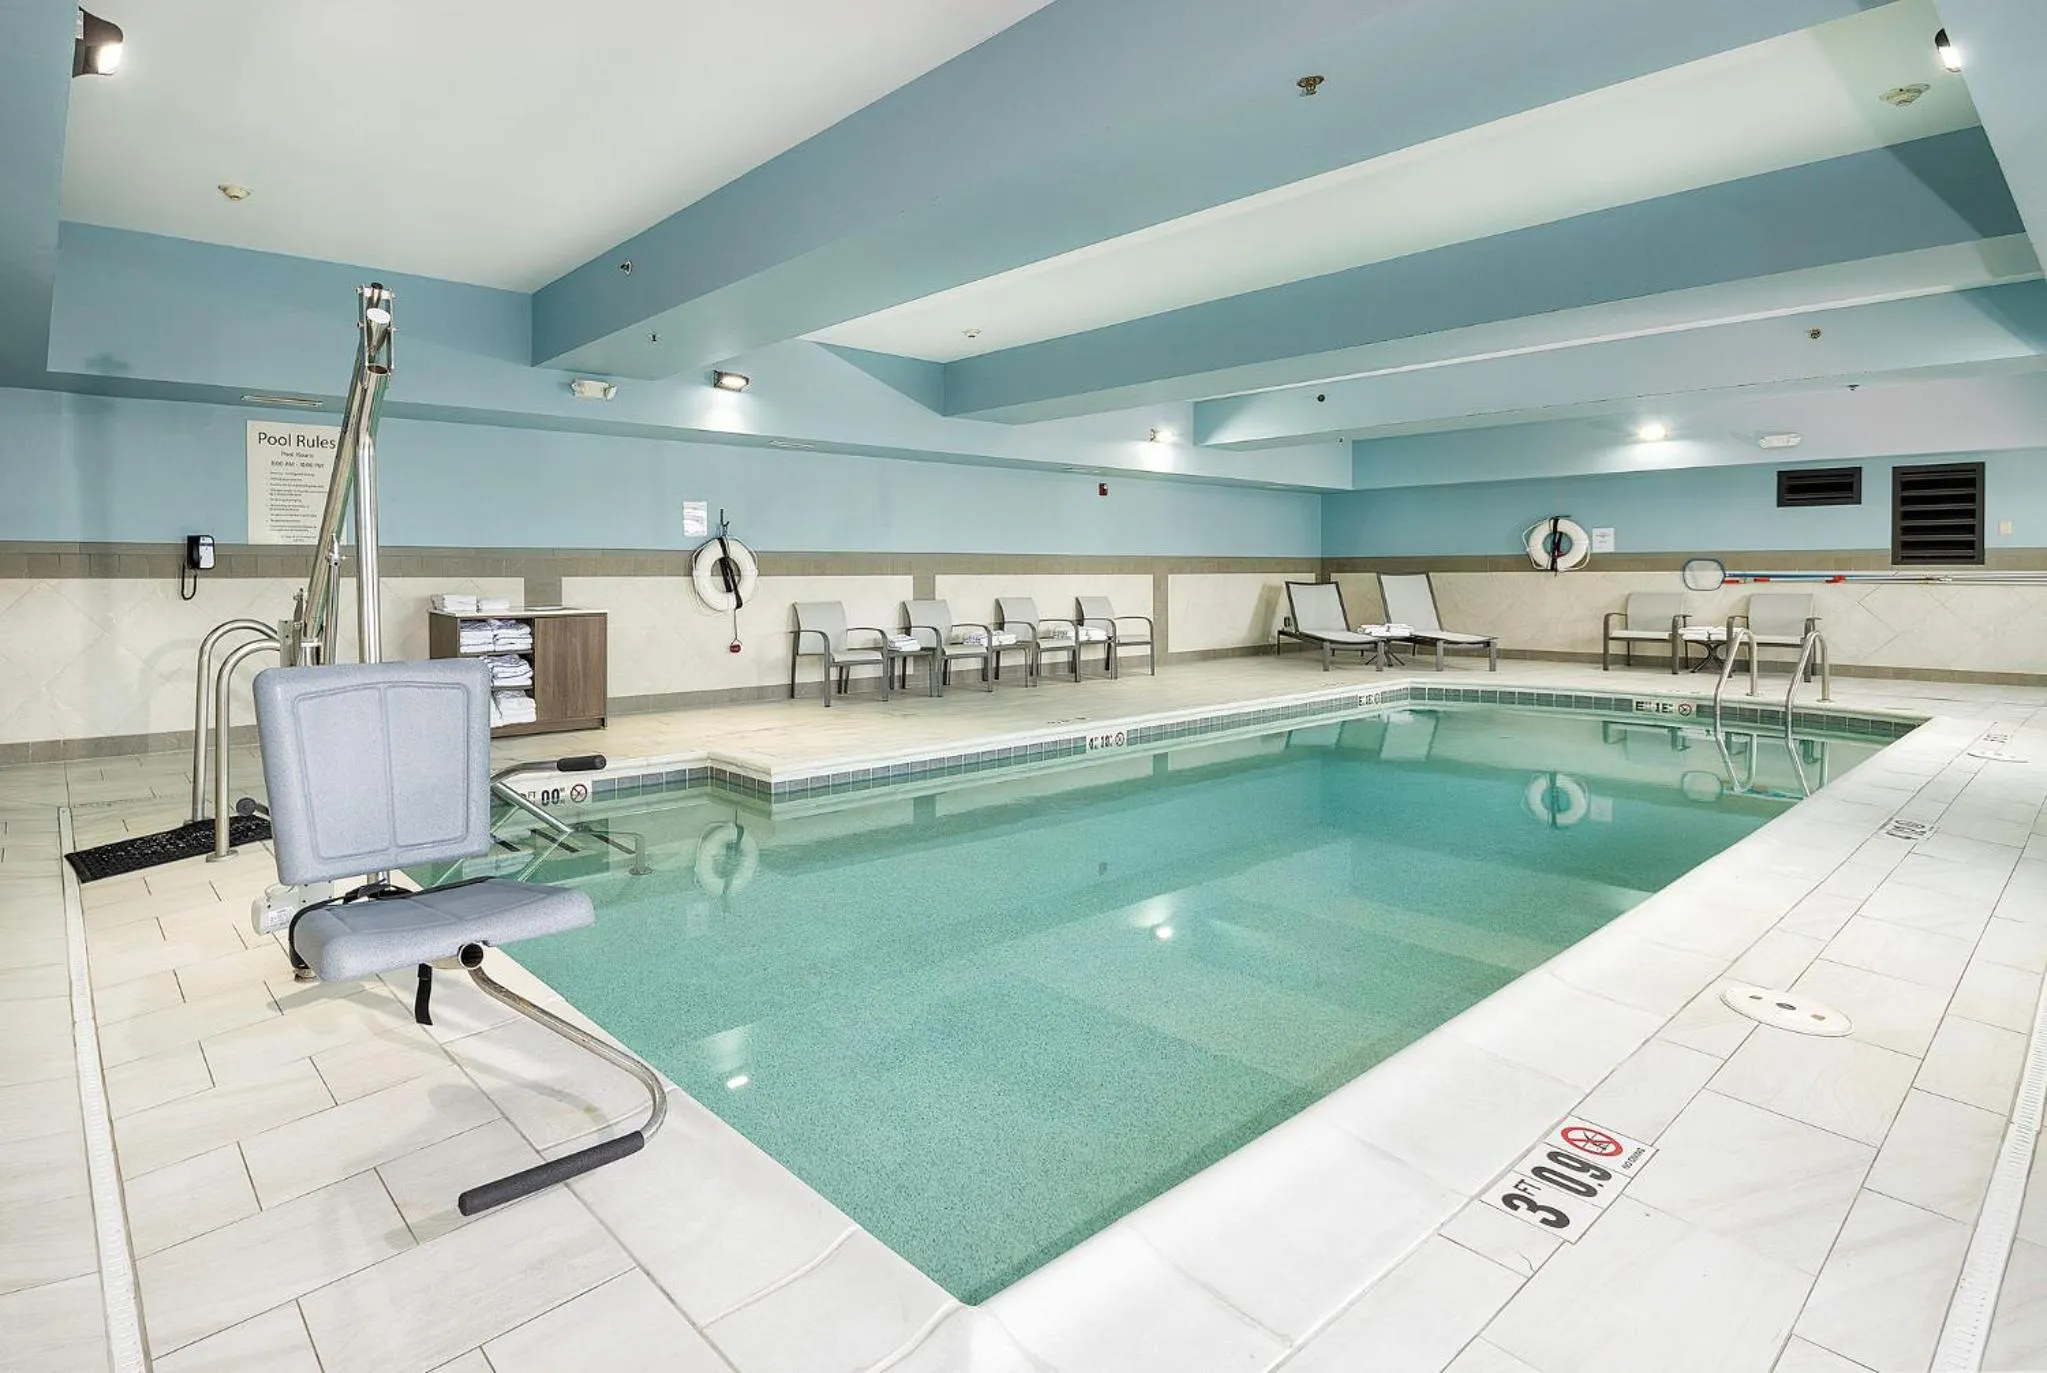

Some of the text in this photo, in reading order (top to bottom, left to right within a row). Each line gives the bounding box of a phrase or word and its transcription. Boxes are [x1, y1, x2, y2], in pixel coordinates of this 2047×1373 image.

[258, 432, 336, 449] Pool Rules
[1512, 1179, 1541, 1196] FT
[1501, 1193, 1570, 1229] 3
